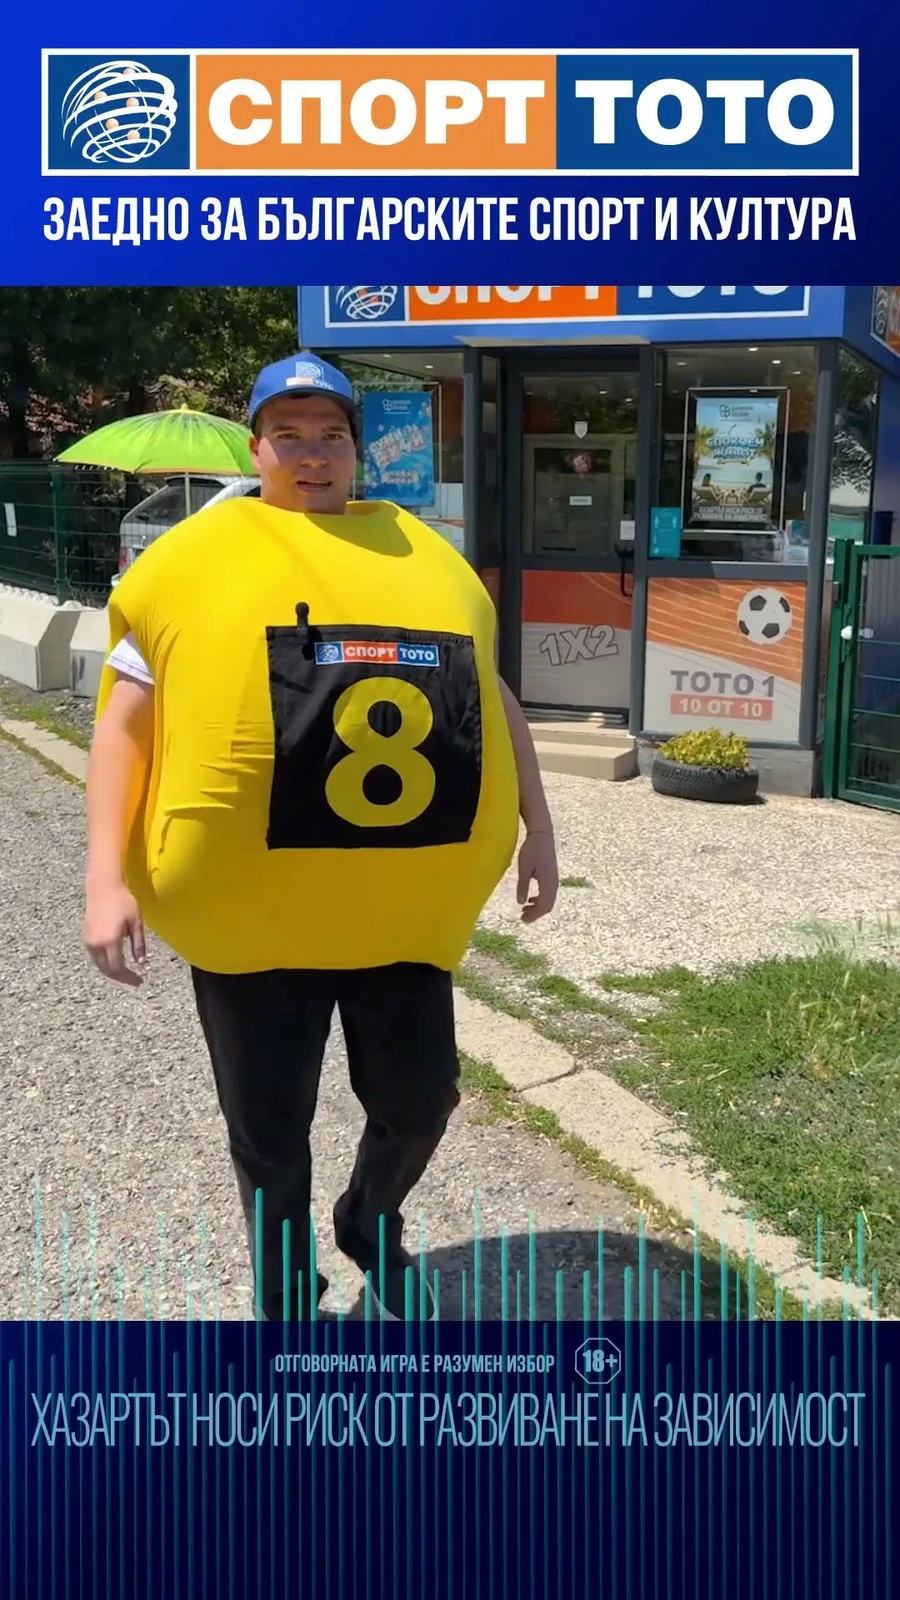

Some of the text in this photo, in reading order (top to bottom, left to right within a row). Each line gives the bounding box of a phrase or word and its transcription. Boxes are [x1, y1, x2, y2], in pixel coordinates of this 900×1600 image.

[345, 646, 434, 660] СПОРТ ТОТО
[670, 670, 775, 697] ТОТО 1
[680, 698, 763, 718] 10 ОТ 10
[325, 676, 436, 827] 8
